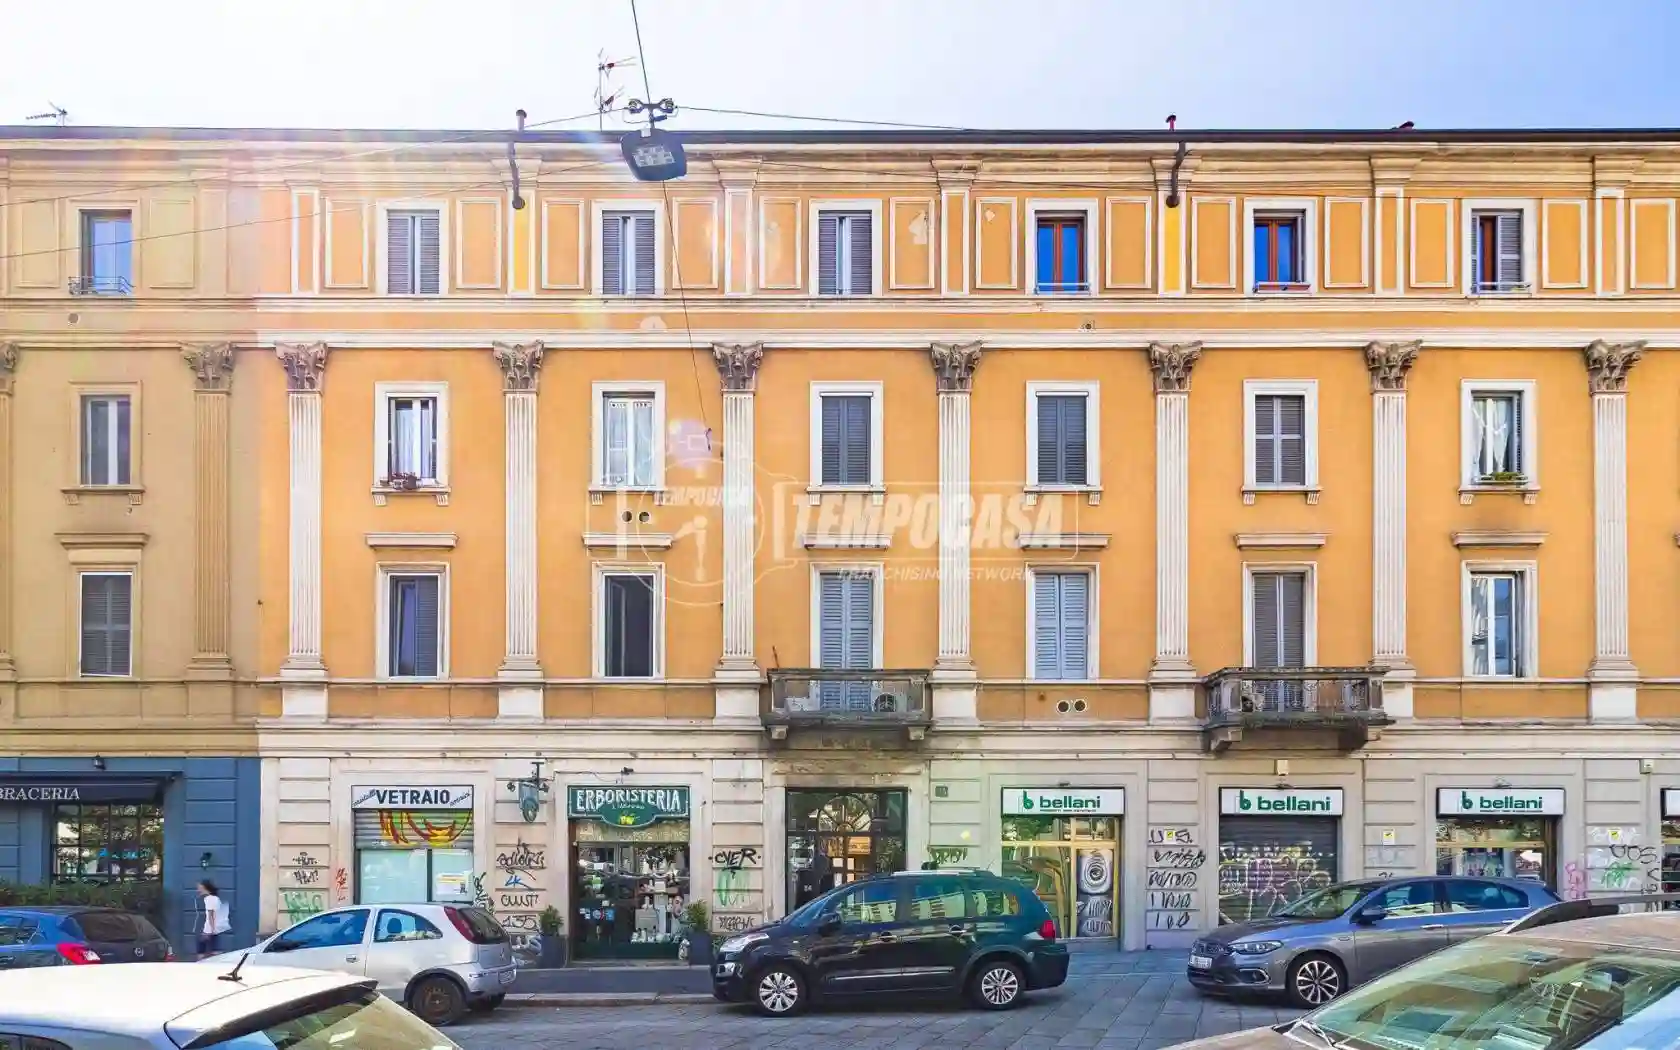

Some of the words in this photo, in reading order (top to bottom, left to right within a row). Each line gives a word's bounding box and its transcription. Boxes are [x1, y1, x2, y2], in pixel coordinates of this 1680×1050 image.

[376, 790, 450, 805] VETRAIO
[576, 789, 681, 811] ERBORISTERIA
[1040, 796, 1101, 808] bellani
[1258, 796, 1331, 811] bellani
[1480, 796, 1543, 808] bellani
